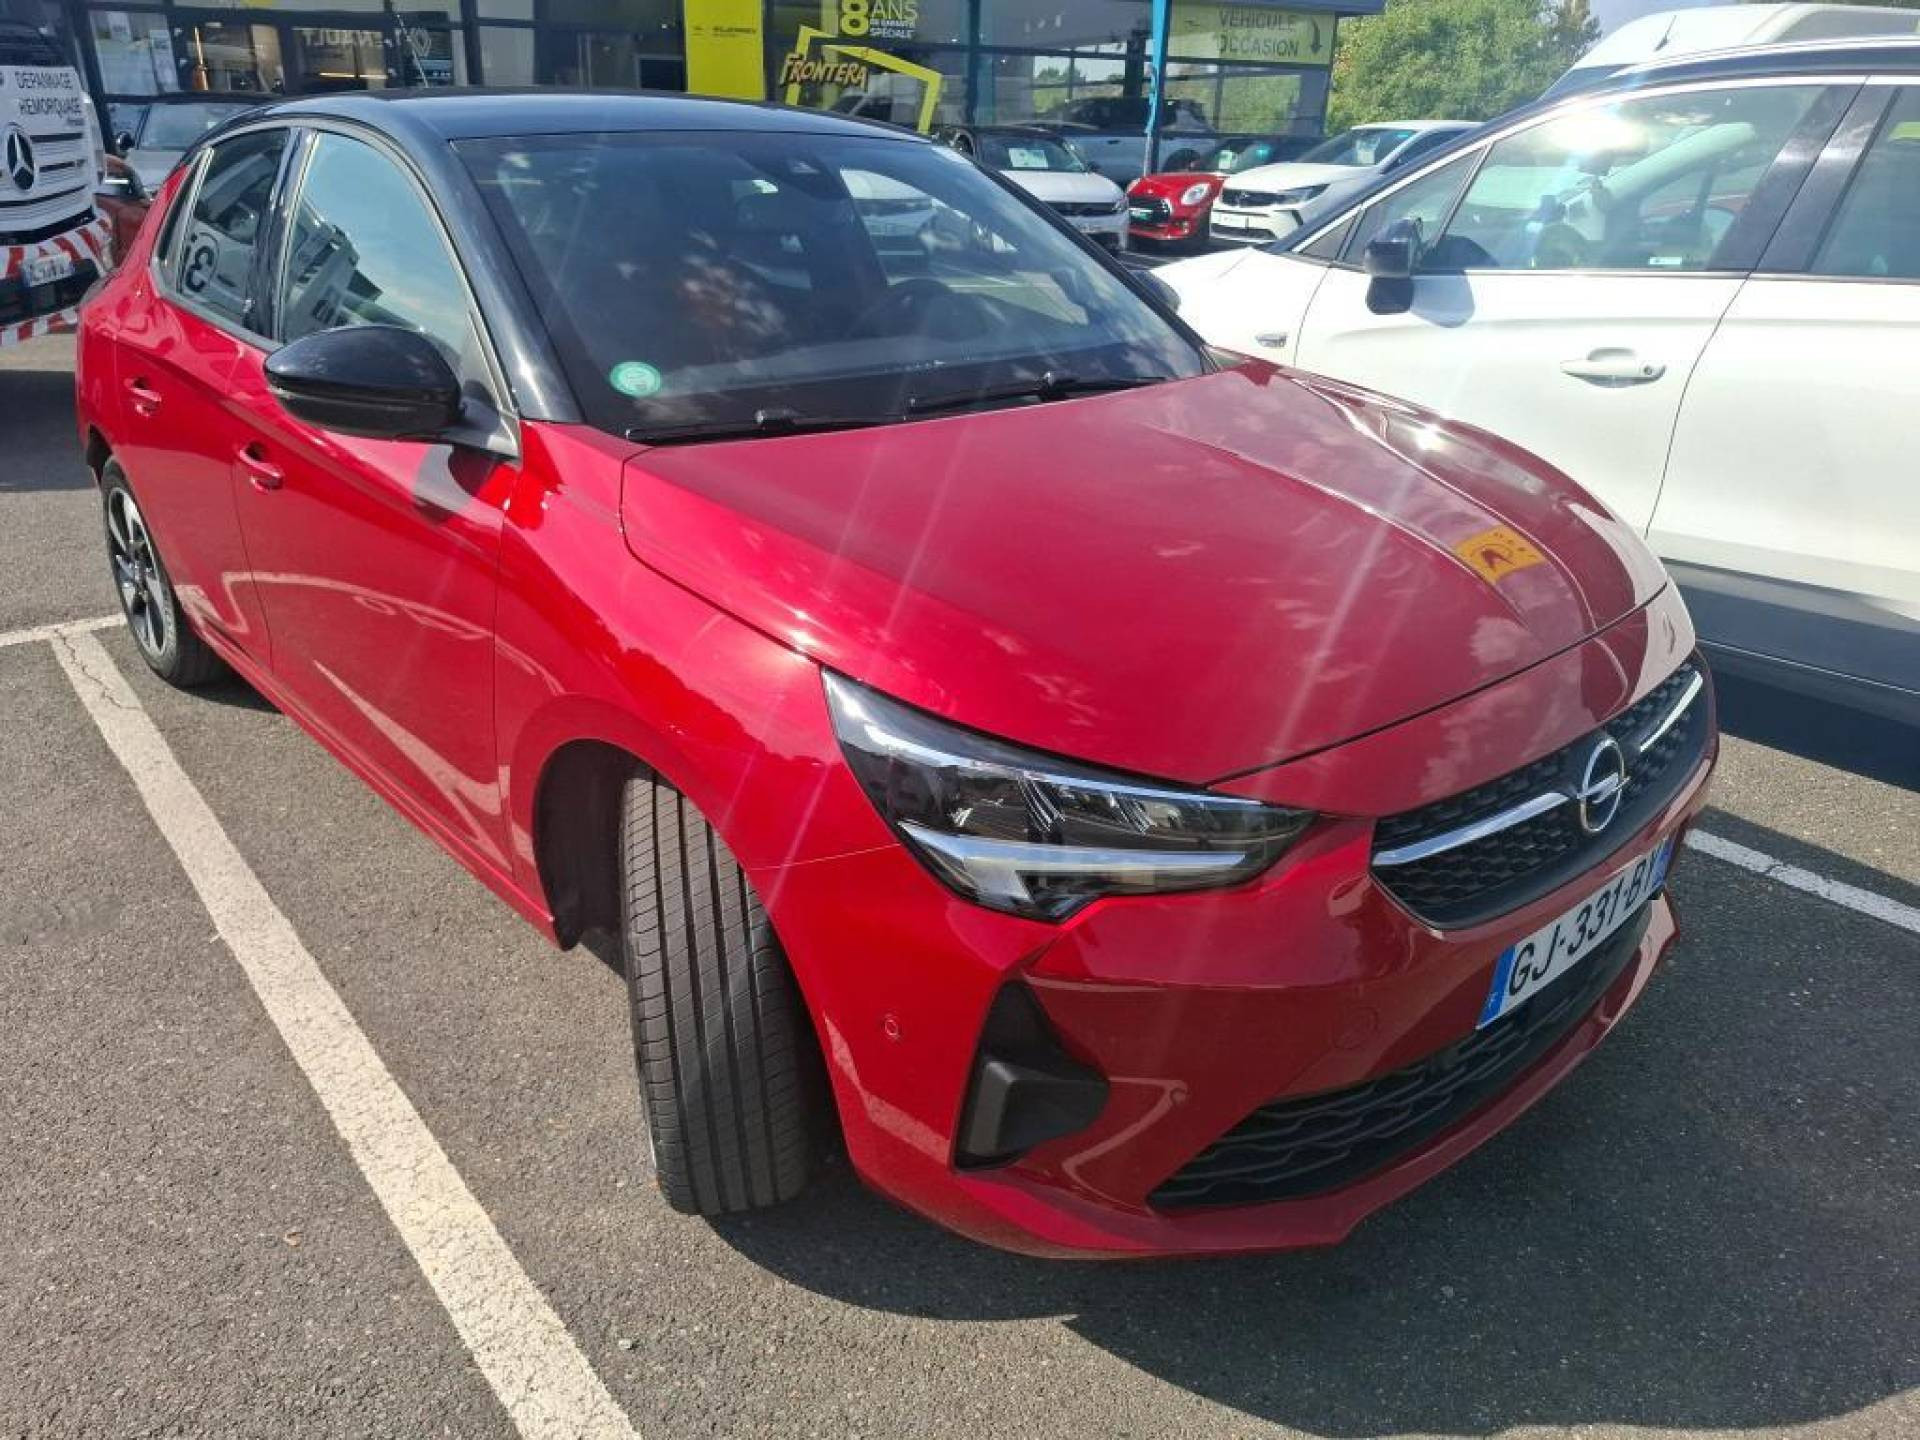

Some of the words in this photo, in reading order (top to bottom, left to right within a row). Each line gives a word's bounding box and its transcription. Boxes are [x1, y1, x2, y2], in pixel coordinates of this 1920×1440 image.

[841, 0, 869, 36] 8
[871, 0, 919, 21] ANS
[1219, 34, 1299, 57] OCCASION
[779, 53, 869, 90] FRONTERA
